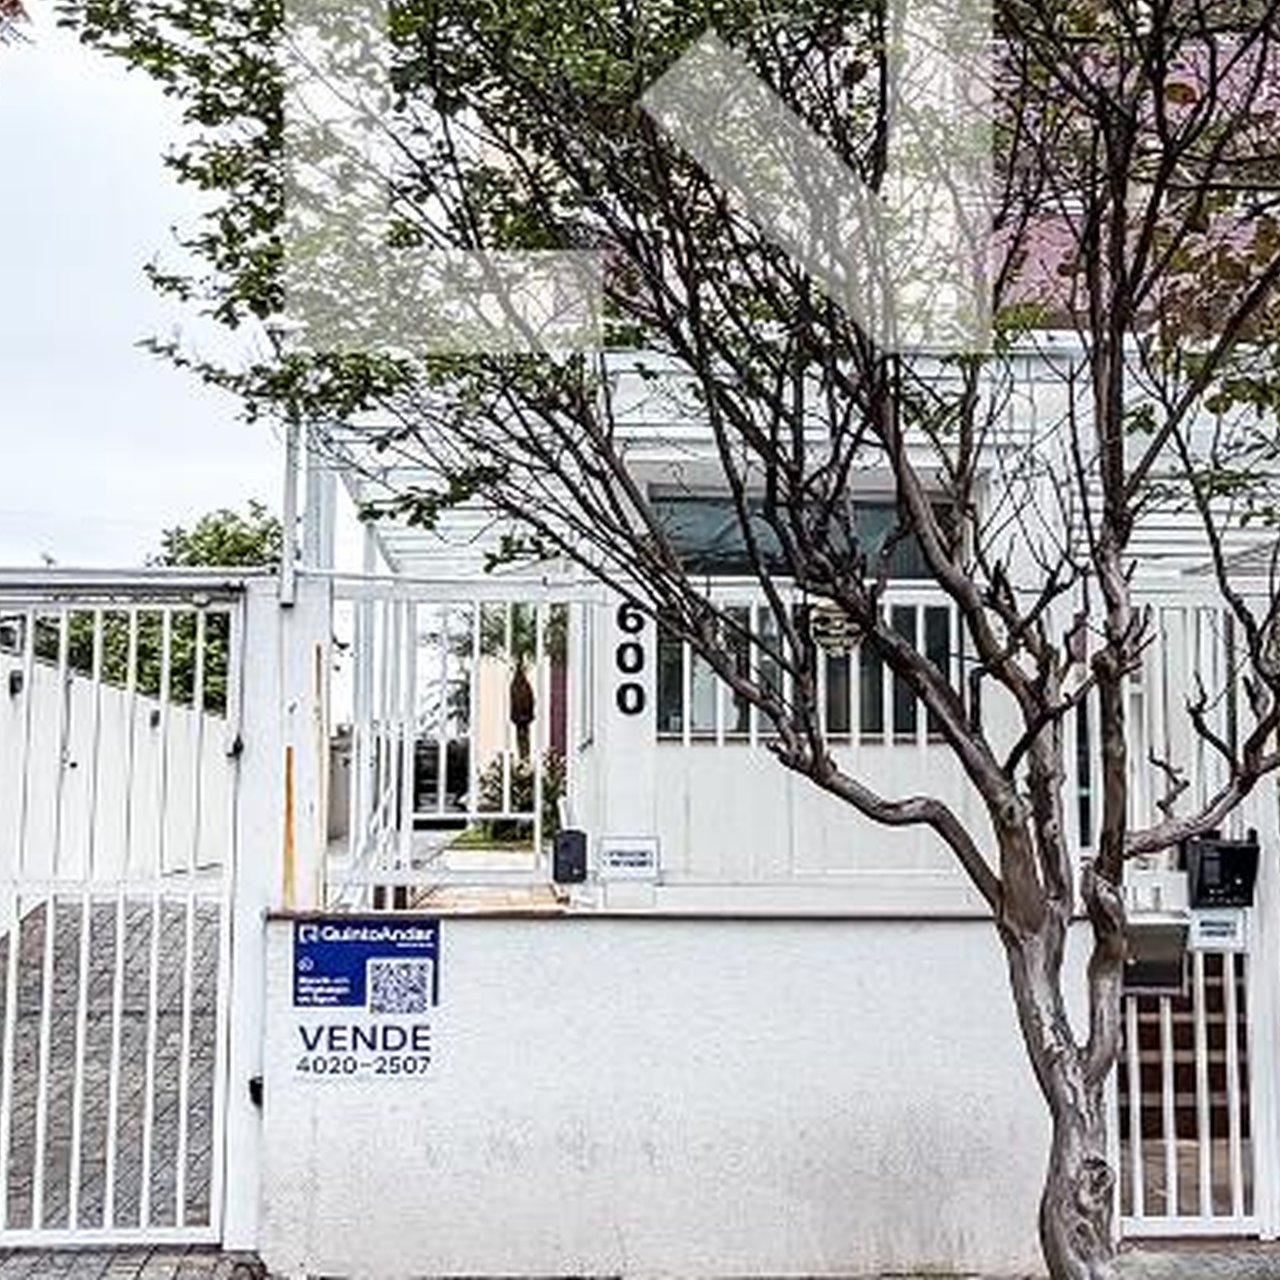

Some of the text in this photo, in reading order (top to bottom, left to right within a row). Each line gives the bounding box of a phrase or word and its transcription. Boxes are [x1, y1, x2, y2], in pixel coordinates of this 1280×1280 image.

[616, 601, 645, 715] 600
[321, 925, 435, 941] QuintoAndar
[298, 1024, 432, 1052] VENDE
[296, 1056, 432, 1075] 4020-2507
